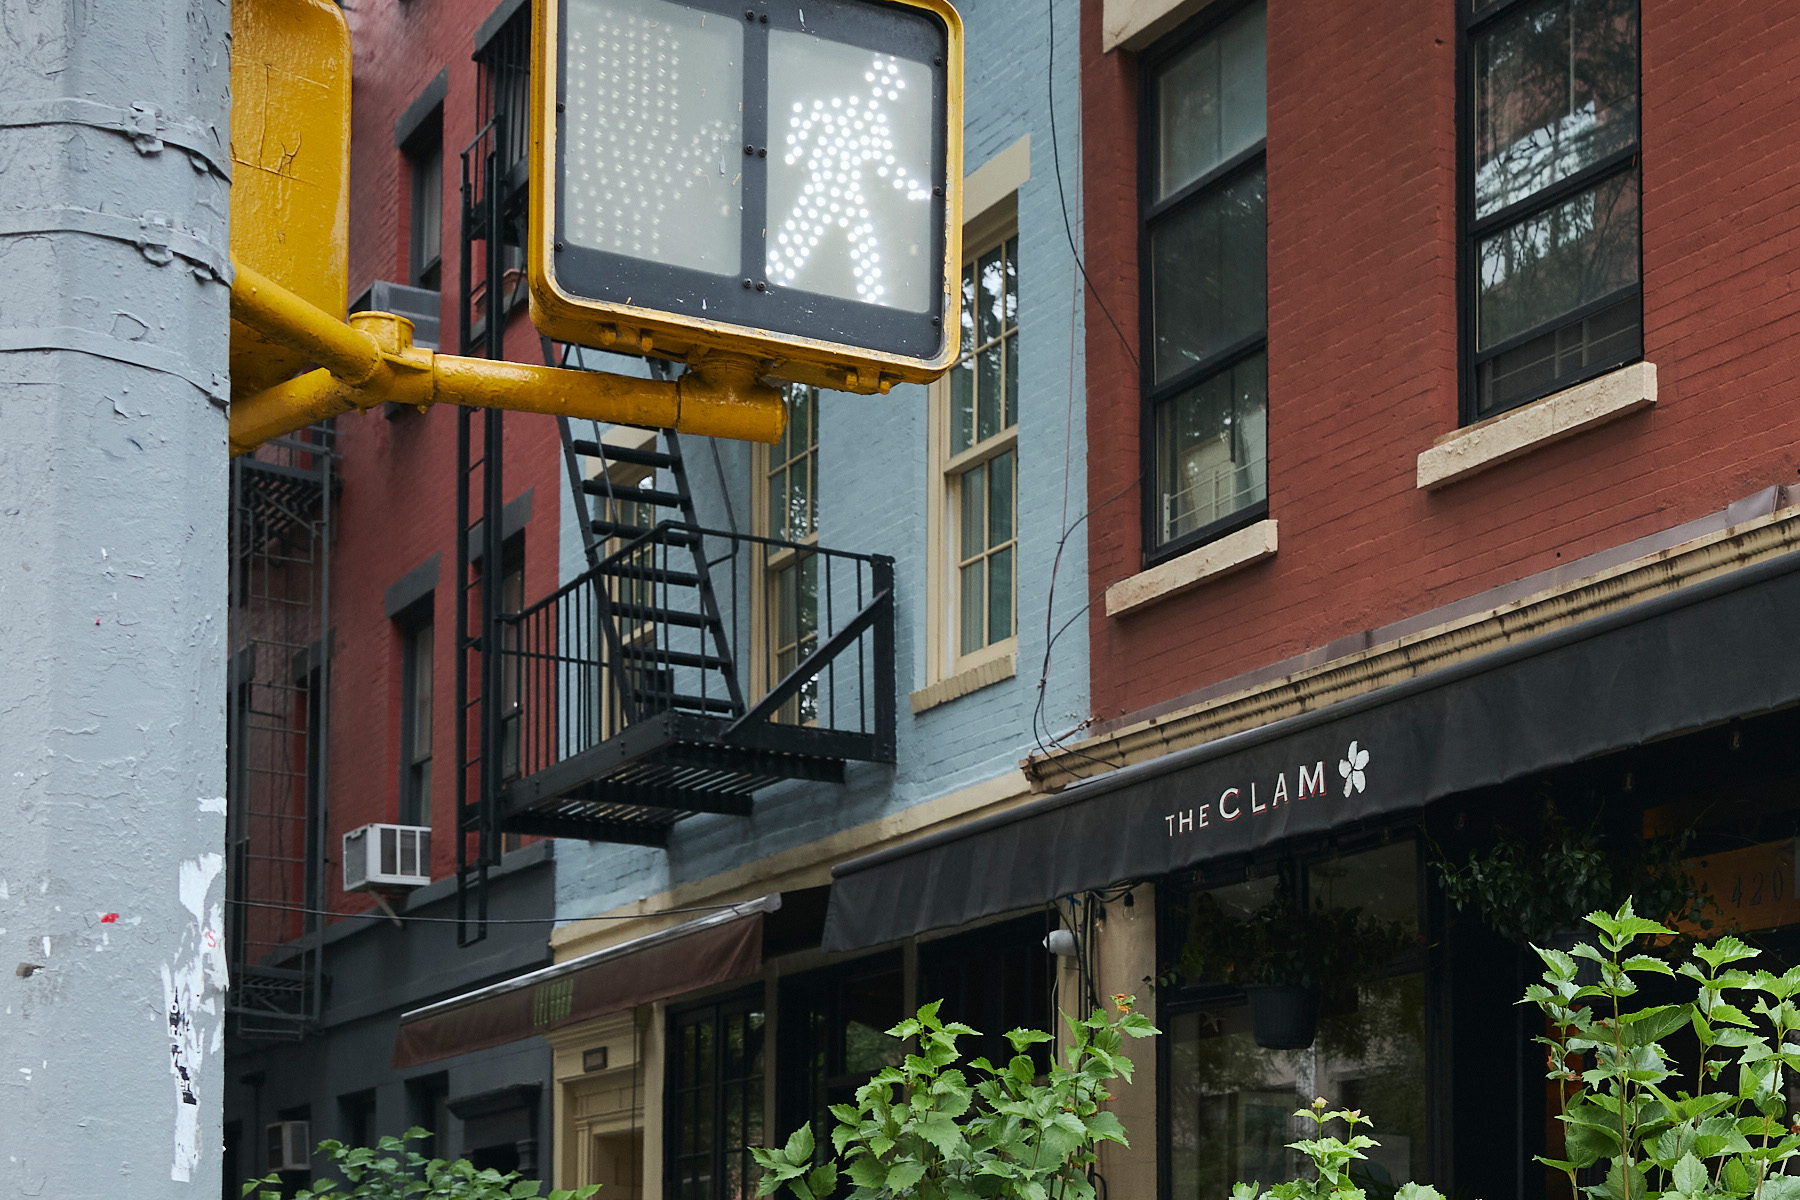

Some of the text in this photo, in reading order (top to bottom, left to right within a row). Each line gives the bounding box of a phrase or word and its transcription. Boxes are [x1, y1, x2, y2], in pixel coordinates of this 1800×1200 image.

[1165, 760, 1327, 837] THE CLAM
[1731, 867, 1784, 909] 420
